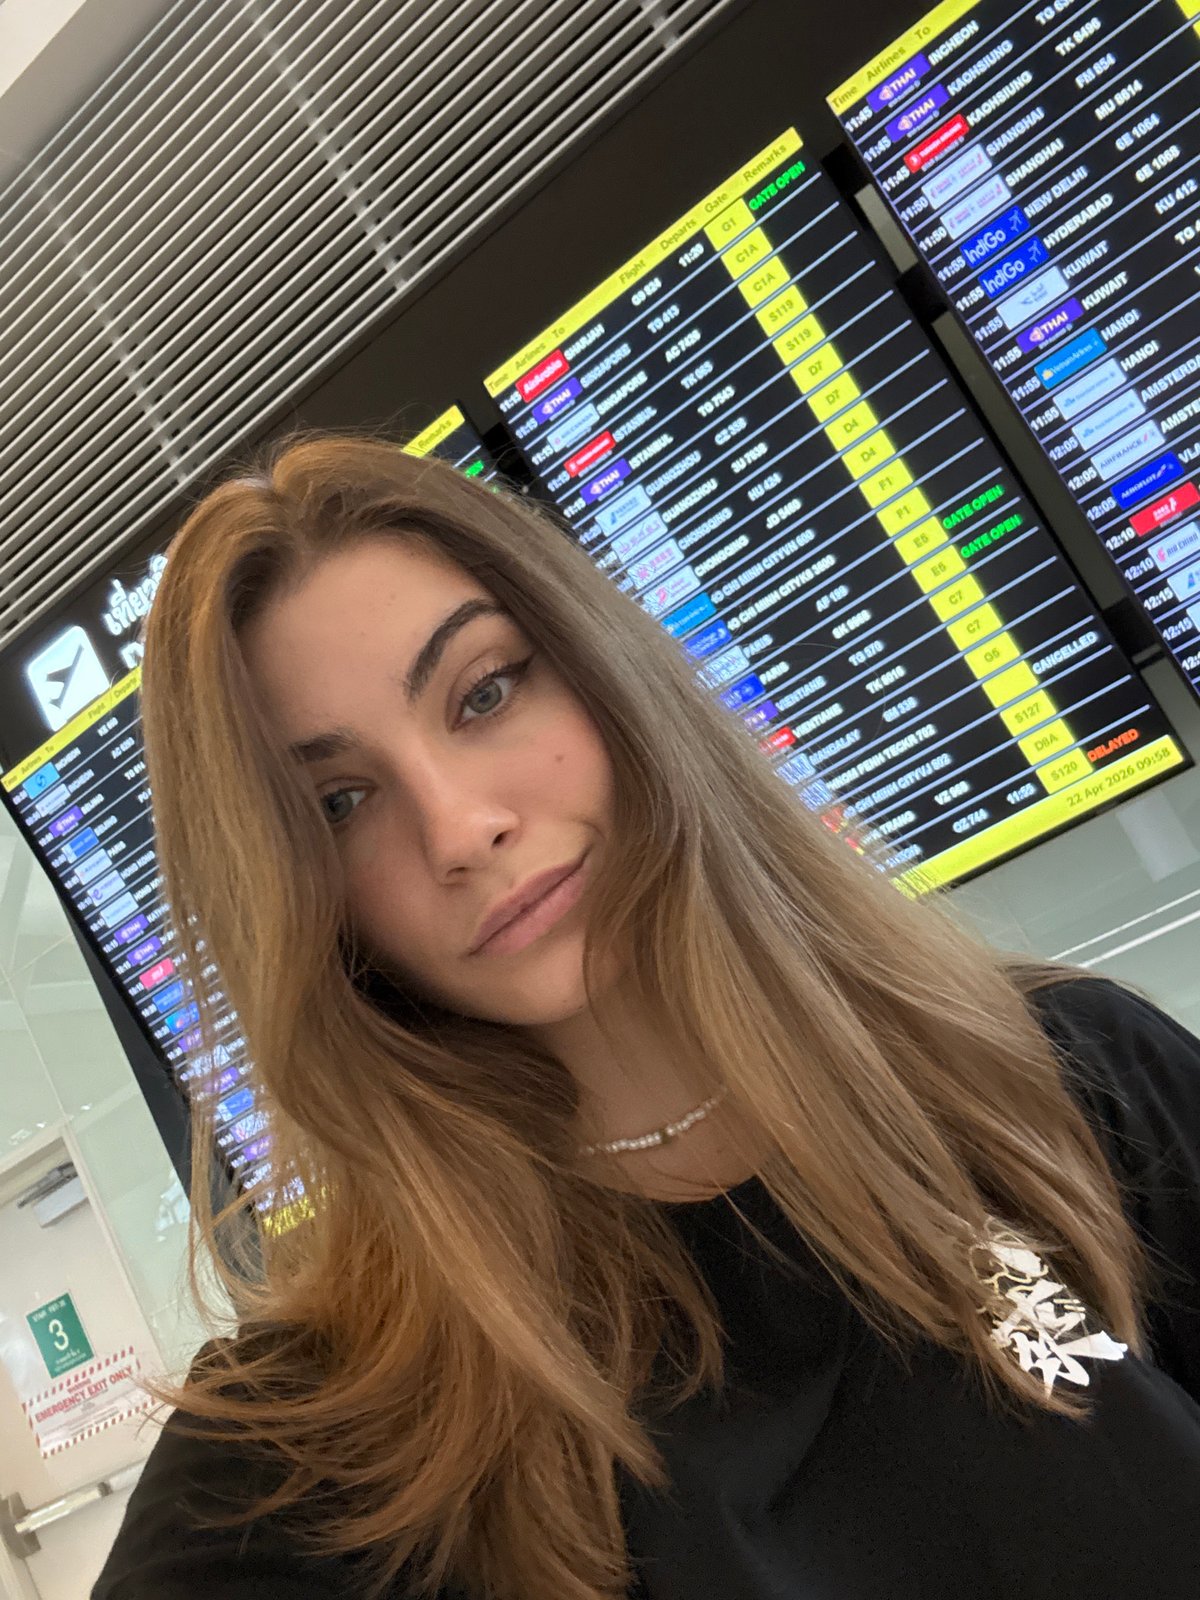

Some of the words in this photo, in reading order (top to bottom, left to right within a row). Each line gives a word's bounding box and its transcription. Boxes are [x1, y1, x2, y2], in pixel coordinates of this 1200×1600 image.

[833, 84, 857, 107] Time
[865, 45, 905, 81] Airlines
[914, 24, 930, 40] To
[844, 106, 872, 132] 11:45
[890, 68, 916, 92] THAI
[928, 20, 979, 65] INCHEON
[863, 135, 891, 162] 11:45
[909, 98, 935, 122] THAI
[947, 38, 1014, 95] KAOHSIUNG
[1035, 5, 1055, 25] TG
[881, 165, 910, 192] 11:45
[966, 69, 1033, 126] KAOHSIUNG
[1055, 37, 1075, 56] TK
[900, 196, 927, 221] 11:50
[985, 107, 1044, 156] SHANGHAI
[1074, 68, 1095, 88] FM
[918, 226, 946, 251] 11:50
[1004, 138, 1064, 186] SHANGHAI
[1094, 99, 1115, 119] MU
[937, 256, 965, 281] 11:55
[964, 225, 1006, 262] IndiGo
[1023, 191, 1053, 217] NEW
[1051, 165, 1088, 197] DELHI
[1131, 112, 1160, 138] 1064
[488, 371, 508, 390] Time
[514, 341, 545, 369] Airlines
[552, 325, 564, 338] To
[619, 259, 646, 284] Flight
[660, 217, 696, 250] Departs
[704, 191, 728, 213] Gate
[744, 143, 786, 181] Remarks
[563, 324, 604, 361] SHARJAH
[721, 217, 736, 232] G1
[748, 184, 778, 211] GATE
[776, 161, 805, 189] OPEN
[955, 285, 984, 311] 11:55
[983, 256, 1025, 292] IndiGo
[1042, 192, 1114, 248] HYDERABAD
[974, 316, 1002, 341] 11:55
[1062, 239, 1110, 278] KUWAIT
[1154, 193, 1175, 213] KU
[1173, 177, 1197, 200] 412
[992, 346, 1021, 370] 11:55
[1041, 311, 1068, 334] THAI
[1081, 270, 1130, 309] KUWAIT
[1173, 225, 1195, 245] TG
[550, 388, 571, 407] THAI
[579, 343, 630, 387] SINGAPORE
[647, 317, 663, 334] TG
[661, 304, 680, 323] 413
[736, 243, 757, 263] C1A
[596, 370, 647, 414] SINGAPORE
[663, 345, 680, 361] AC
[753, 271, 775, 292] C1A
[612, 403, 656, 441] ISTANBUL
[680, 373, 696, 389] TK
[768, 299, 794, 322] S119
[1011, 376, 1040, 400] 11:55
[1100, 308, 1140, 340] HANOI
[1030, 406, 1059, 430] 11:55
[1120, 339, 1160, 370] HANOI
[599, 469, 620, 488] THAI
[628, 431, 673, 468] ISTANBUL
[697, 400, 713, 416] TG
[786, 327, 811, 350] S119
[644, 449, 701, 495] GUANGZHOU
[808, 360, 823, 375] D7
[661, 477, 717, 522] GUANGZHOU
[825, 389, 841, 404] D7
[1048, 436, 1078, 460] 12:05
[677, 505, 733, 549] CHONGQING
[747, 484, 764, 500] HU
[843, 417, 858, 432] D4
[693, 533, 749, 575] CHONGQING
[763, 512, 779, 527] JD
[860, 446, 876, 461] D4
[721, 578, 739, 595] CHI
[737, 562, 763, 584] MINH
[878, 476, 892, 489] F1
[1067, 466, 1097, 490] 12:05
[1086, 496, 1116, 520] 12:05
[738, 605, 756, 622] CHI
[754, 590, 780, 611] MINH
[896, 504, 910, 518] F1
[742, 632, 773, 657] PARIS
[814, 595, 831, 611] AF
[941, 504, 972, 529] GATE
[971, 483, 1004, 510] OPEN
[1104, 527, 1135, 550] 12:10
[1123, 557, 1154, 581] 12:10
[759, 660, 789, 684] PARIS
[959, 533, 990, 558] GATE
[989, 513, 1022, 539] OPEN
[775, 675, 826, 711] VIENTIANE
[848, 651, 865, 666] TG
[948, 590, 964, 604] C7
[1142, 587, 1173, 611] 12:15
[1161, 618, 1192, 641] 12:15
[88, 702, 105, 719] Flight
[791, 702, 843, 738] VIENTIANE
[865, 679, 882, 694] TK
[965, 619, 982, 633] C7
[857, 752, 885, 774] PENH
[1031, 630, 1098, 673] CANCELLED
[808, 729, 861, 765] MANDALAY
[872, 782, 899, 802] MINH
[1014, 702, 1041, 722] S127
[1049, 760, 1078, 780] S120
[1086, 727, 1139, 760] DELAYED
[1067, 793, 1083, 806] 22
[1082, 782, 1105, 800] Apr
[1105, 766, 1135, 786] 2026
[1135, 747, 1170, 770] 09:58
[880, 810, 916, 834] TRANG
[934, 790, 951, 805] VZ
[35, 1389, 87, 1422] EMERGENCY
[87, 1378, 109, 1399] EXIT
[109, 1365, 133, 1386] ONLY
[48, 1319, 69, 1351] 3
